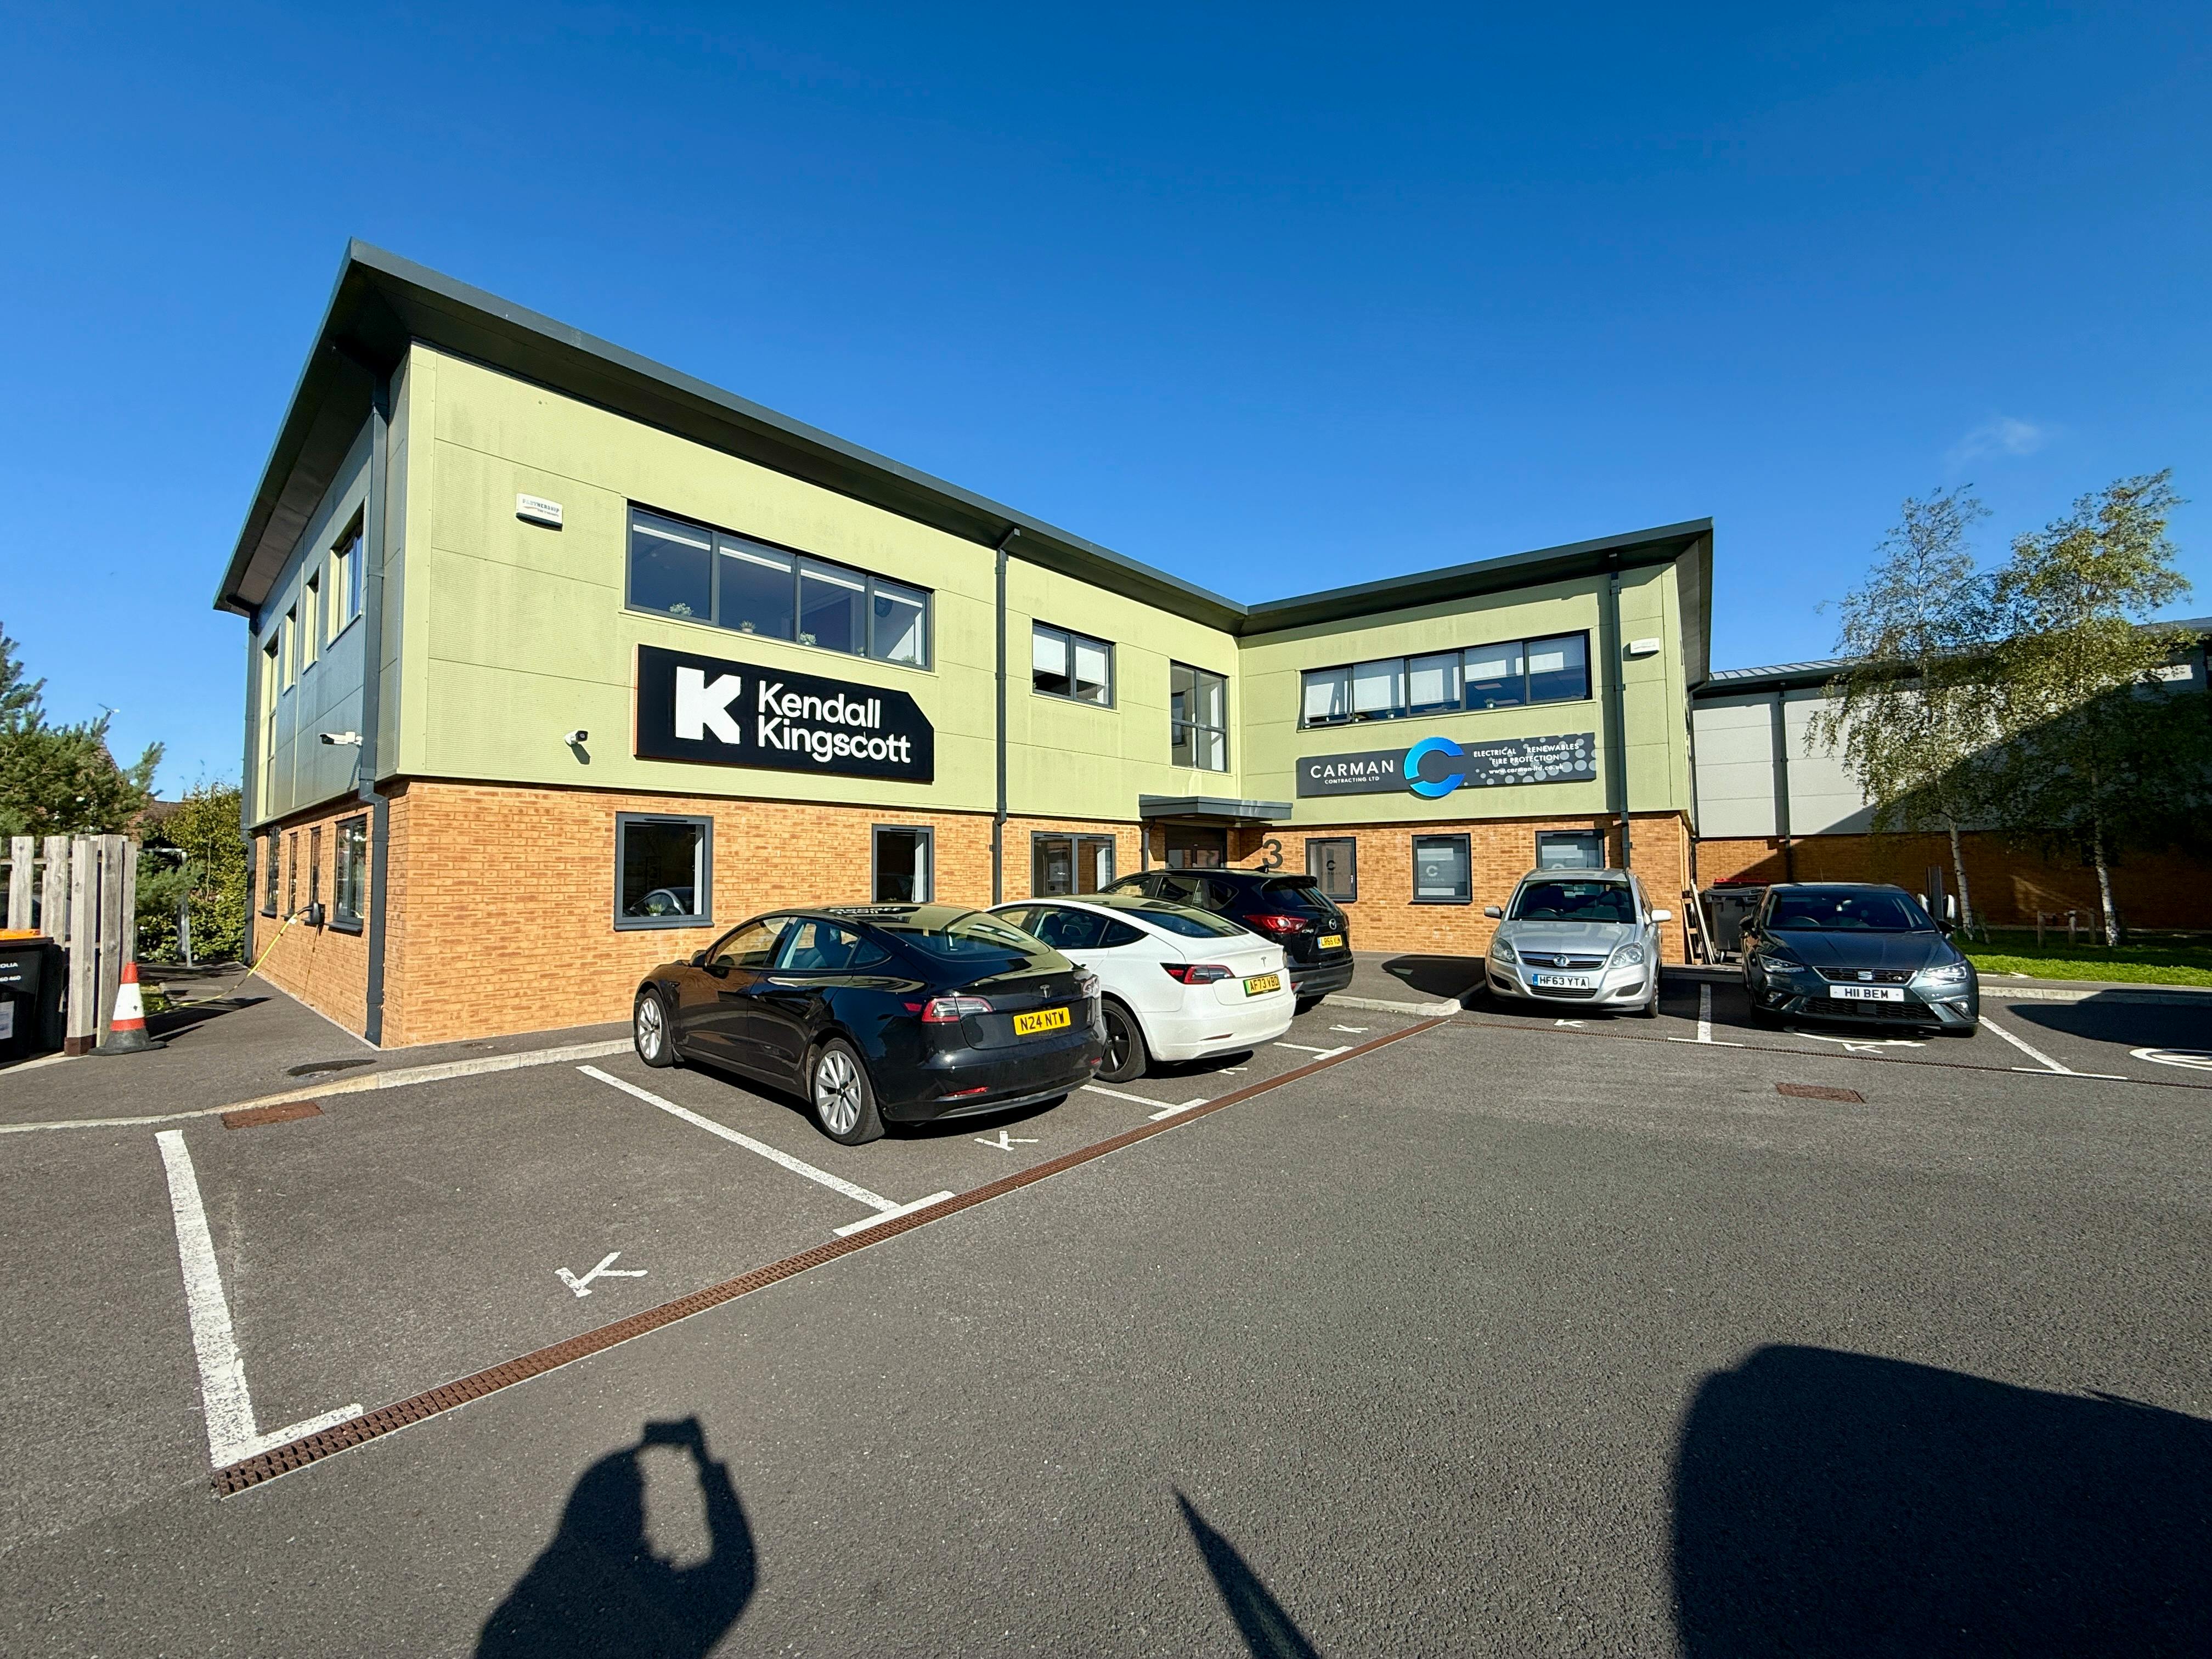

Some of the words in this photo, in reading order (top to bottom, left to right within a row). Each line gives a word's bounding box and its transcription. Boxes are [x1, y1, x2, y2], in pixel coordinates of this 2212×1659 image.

[675, 665, 742, 745] K
[758, 680, 881, 729] Kendall
[758, 715, 911, 763] Kingscott
[1473, 748, 1517, 758] ELECTRICAL
[1526, 743, 1579, 753] RENEWABLES
[1510, 754, 1560, 764] PROTECTION
[1310, 759, 1394, 778] CARMAN
[1488, 763, 1564, 775] www.carman-ltd.co.uk
[1324, 776, 1367, 785] CONTRACTING
[1262, 839, 1283, 869] 3
[1250, 978, 1267, 991] AF73
[1539, 976, 1565, 985] HF63
[1567, 978, 1587, 986] YTA
[1863, 989, 1888, 998] BEM
[1020, 1014, 1042, 1031] N24
[1045, 1011, 1064, 1026] NTW
